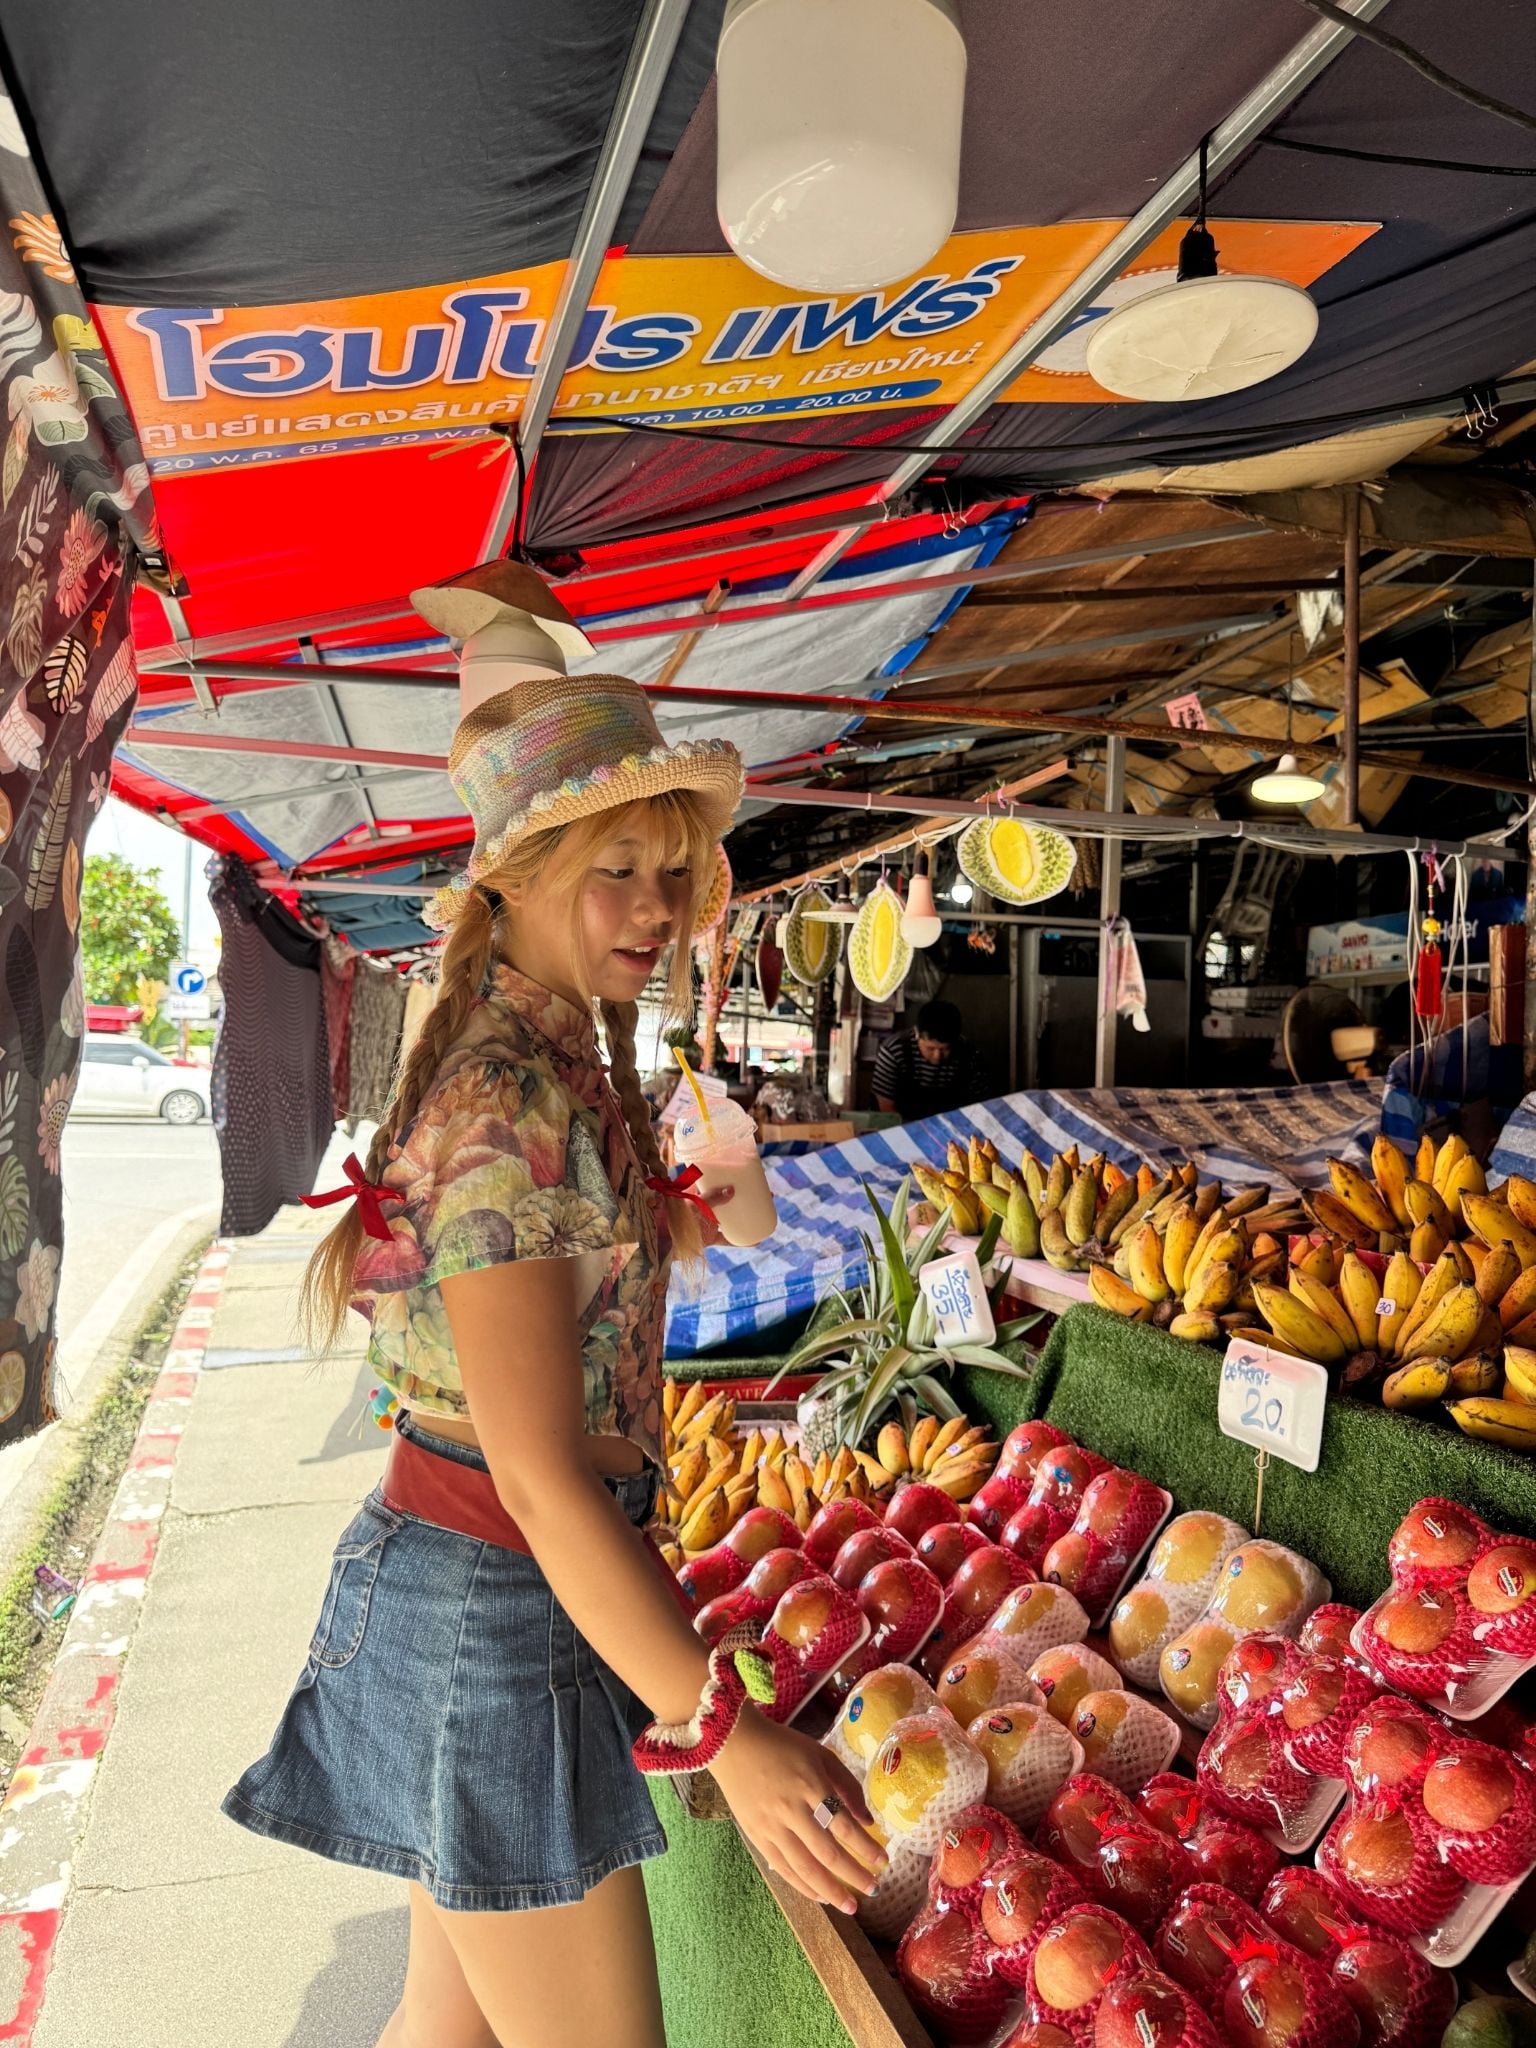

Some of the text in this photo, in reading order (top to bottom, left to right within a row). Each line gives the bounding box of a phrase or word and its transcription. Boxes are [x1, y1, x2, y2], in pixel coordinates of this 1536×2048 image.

[126, 255, 1026, 401] โฮมโปร แฟร์
[798, 341, 985, 386] เชียงใหม่
[617, 413, 676, 425] วลา
[691, 402, 765, 421] 10.00
[794, 390, 873, 410] 20.00
[152, 457, 195, 473] 20
[298, 442, 339, 454] 65
[382, 432, 420, 446] 29
[434, 427, 491, 440] พ.ค
